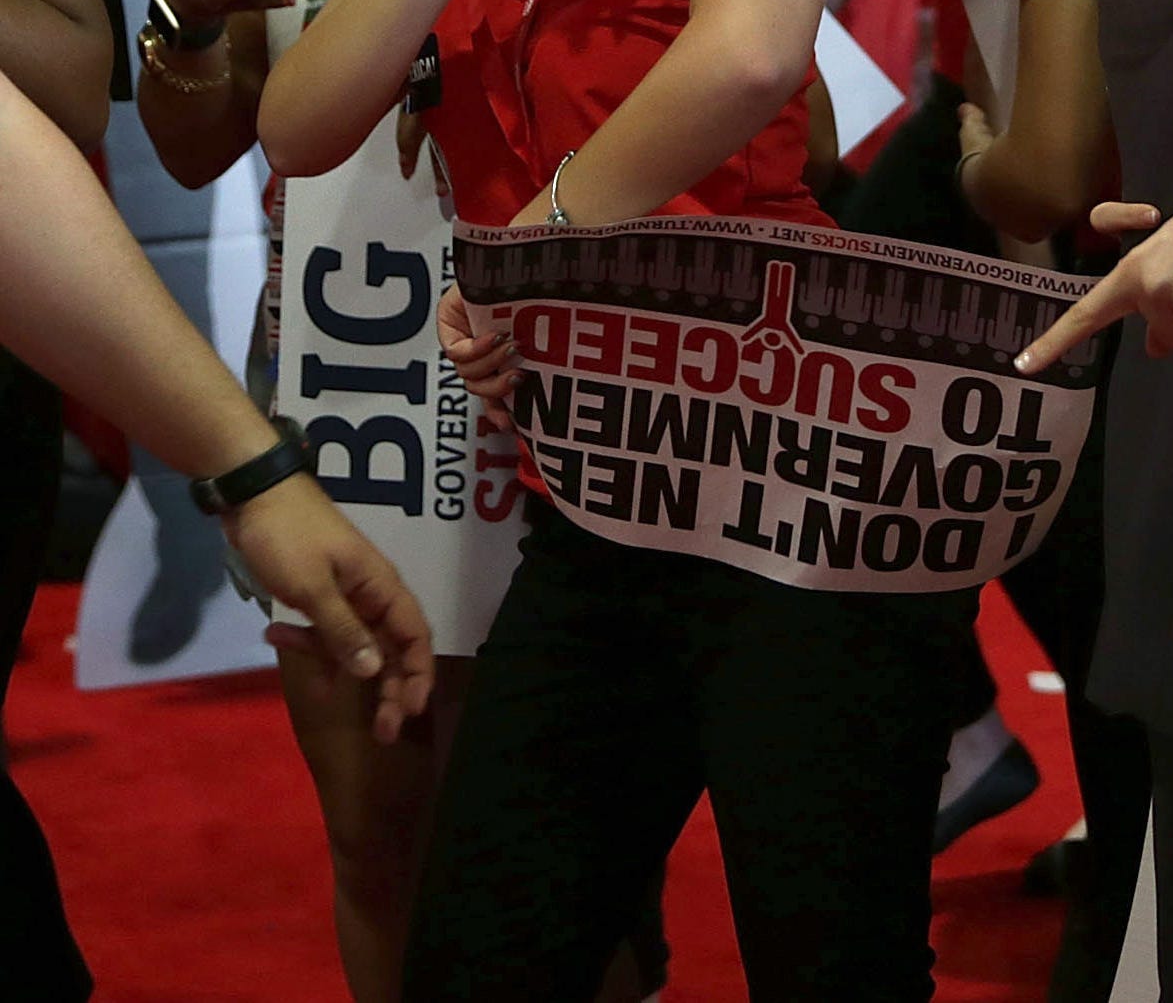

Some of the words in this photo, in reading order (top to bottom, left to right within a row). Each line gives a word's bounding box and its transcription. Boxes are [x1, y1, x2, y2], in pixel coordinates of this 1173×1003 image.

[466, 219, 754, 244] WWW.TURNINGPOINTUSA.NET
[301, 241, 432, 518] BIG
[434, 246, 469, 522] GOVERNT
[490, 305, 918, 434] SUCCEED.
[941, 377, 1053, 454] TO
[512, 370, 1063, 515] GOVERNMEN
[521, 438, 701, 530] NEE
[722, 480, 986, 573] DON'T
[1003, 513, 1036, 560] I
